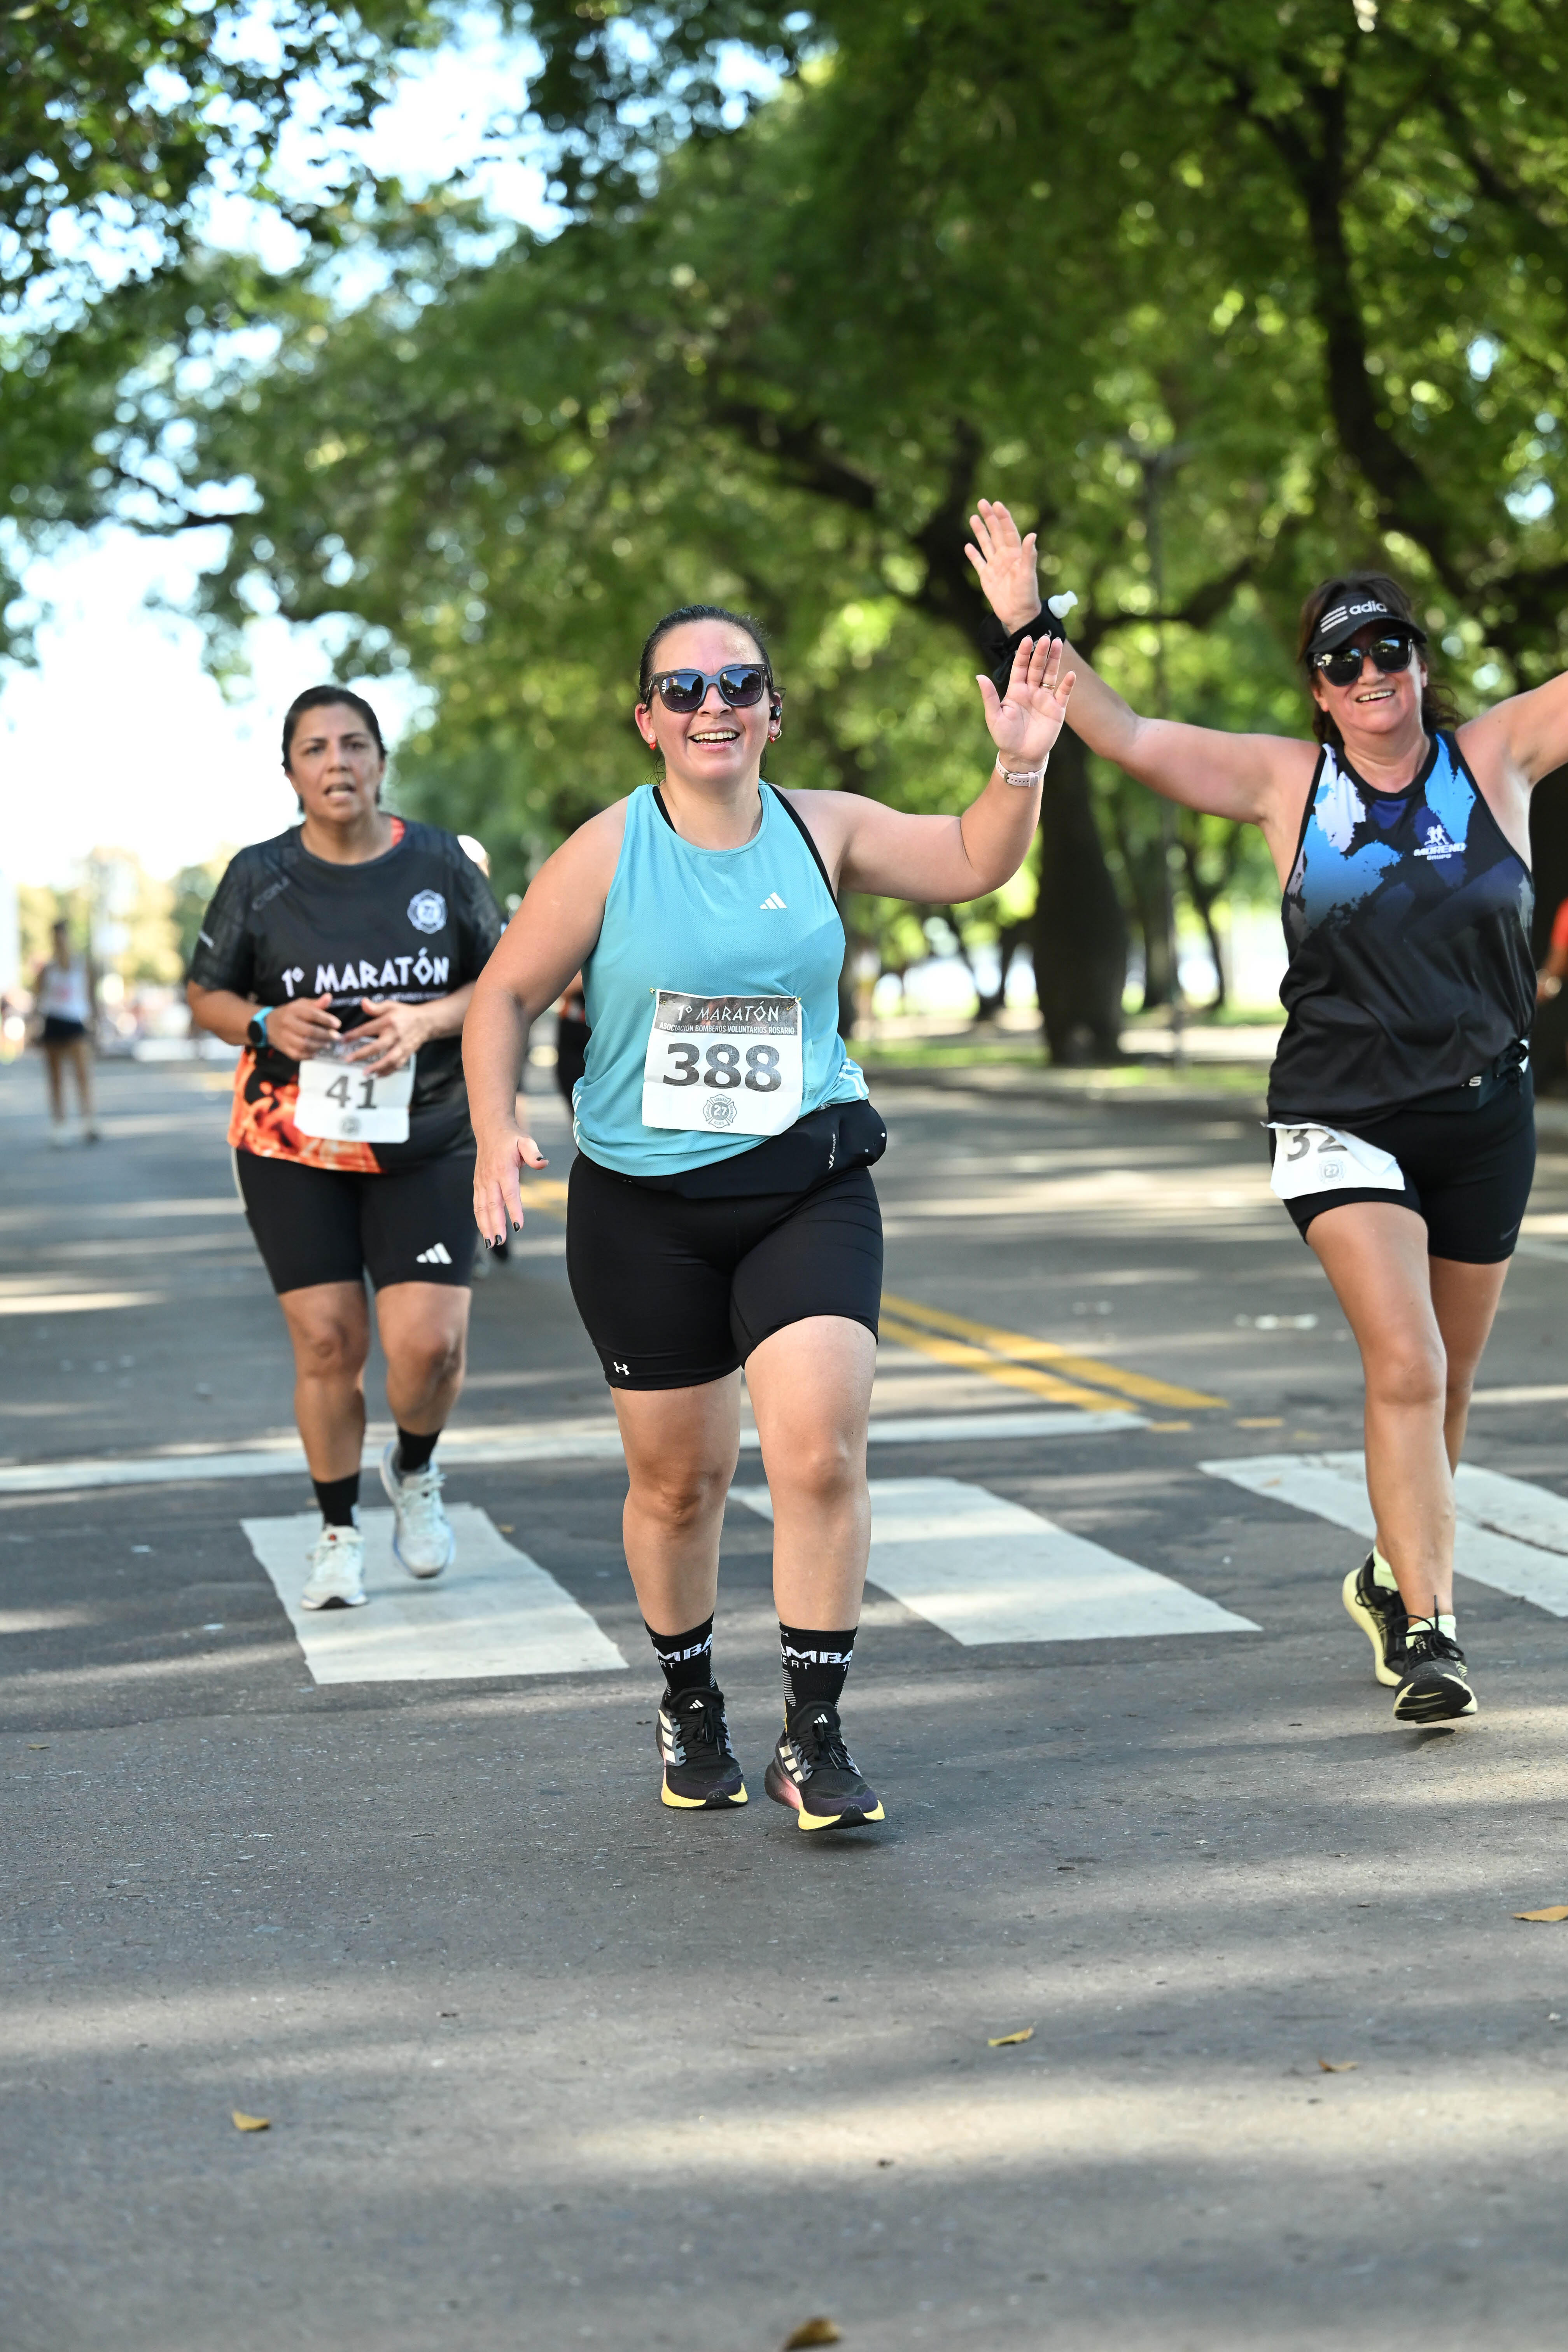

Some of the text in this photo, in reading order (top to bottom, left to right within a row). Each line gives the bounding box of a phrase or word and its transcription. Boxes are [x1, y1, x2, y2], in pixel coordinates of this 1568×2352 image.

[1414, 842, 1466, 856] MORENO
[314, 947, 450, 994] MARATÓN
[695, 1001, 779, 1022] MARATÓN
[663, 1043, 782, 1092] 388
[325, 1076, 377, 1109] 41
[714, 1104, 727, 1116] 27
[1286, 1129, 1348, 1162] 32
[654, 1634, 712, 1661] MBA
